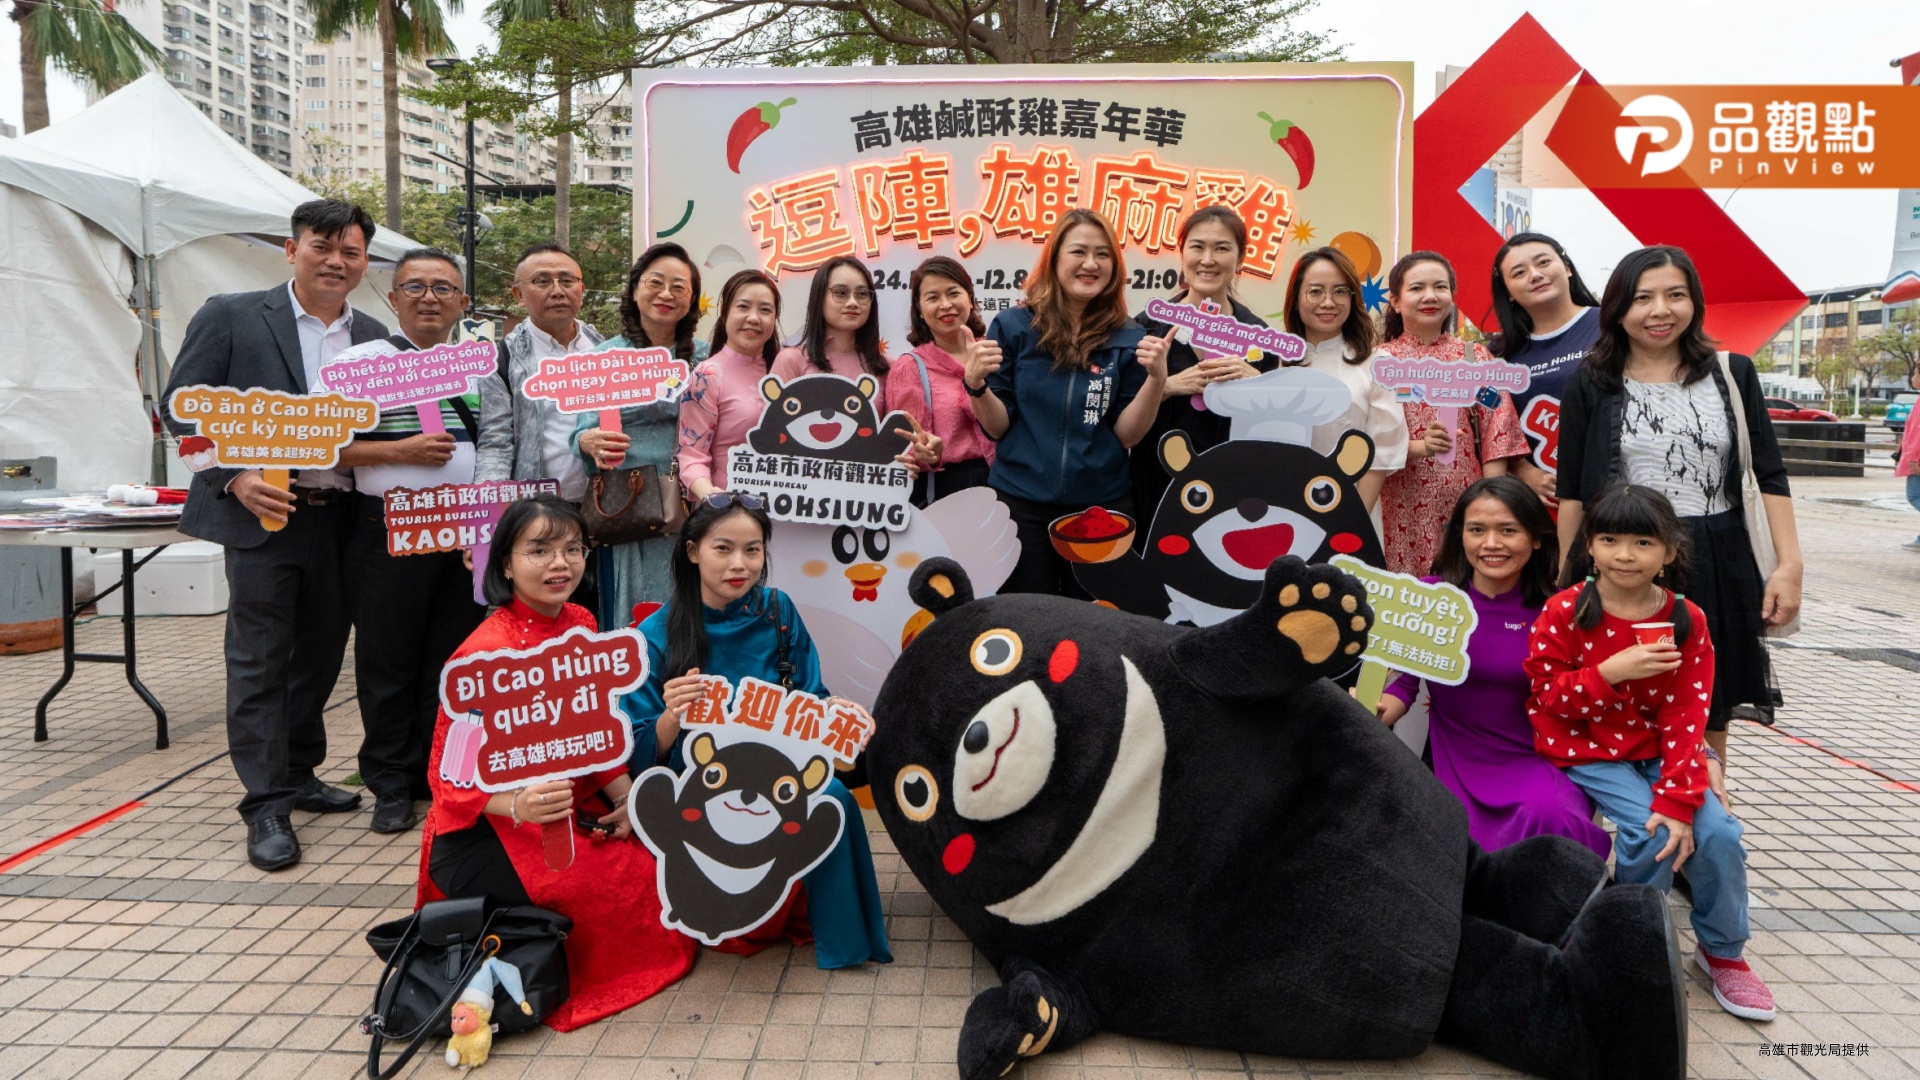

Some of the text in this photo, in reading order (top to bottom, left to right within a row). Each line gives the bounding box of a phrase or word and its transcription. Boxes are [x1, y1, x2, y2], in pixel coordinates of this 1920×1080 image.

[850, 96, 1187, 153] 高雄鹹酥雞嘉年華
[1152, 303, 1173, 318] Cao
[1257, 334, 1272, 346] có
[1273, 336, 1300, 355] thật
[327, 344, 491, 382] Bỏ hết áp lực cuộc sống
[366, 374, 394, 389] đến
[396, 368, 419, 384] với
[421, 367, 447, 380] Cao
[450, 360, 491, 375] Hùng.
[546, 353, 664, 376] Du lịch Đài Loan
[1380, 365, 1523, 385] Tận hưởng Cao Hùng
[530, 366, 681, 394] chọn ngay Cao Hùng
[1430, 387, 1470, 399] 享受高雄
[183, 396, 369, 422] Đồ ăn ở Cao Hùng
[209, 418, 343, 441] cực kỳ ngon!
[226, 445, 328, 460] 高雄美食超好吃
[732, 451, 908, 488] 高雄市政府觀光局
[733, 477, 808, 491] TOURISM BUREAU
[390, 510, 489, 527] TOURISM BUREAU
[732, 489, 905, 526] AOHSIUNG
[392, 523, 498, 552] KAOHS
[1400, 587, 1466, 625] tuyệt,
[1505, 621, 1522, 631] tugo
[457, 647, 631, 702] Đi Cao Hùng
[492, 684, 599, 734] quẩy đi
[686, 678, 867, 760] 歡迎你來
